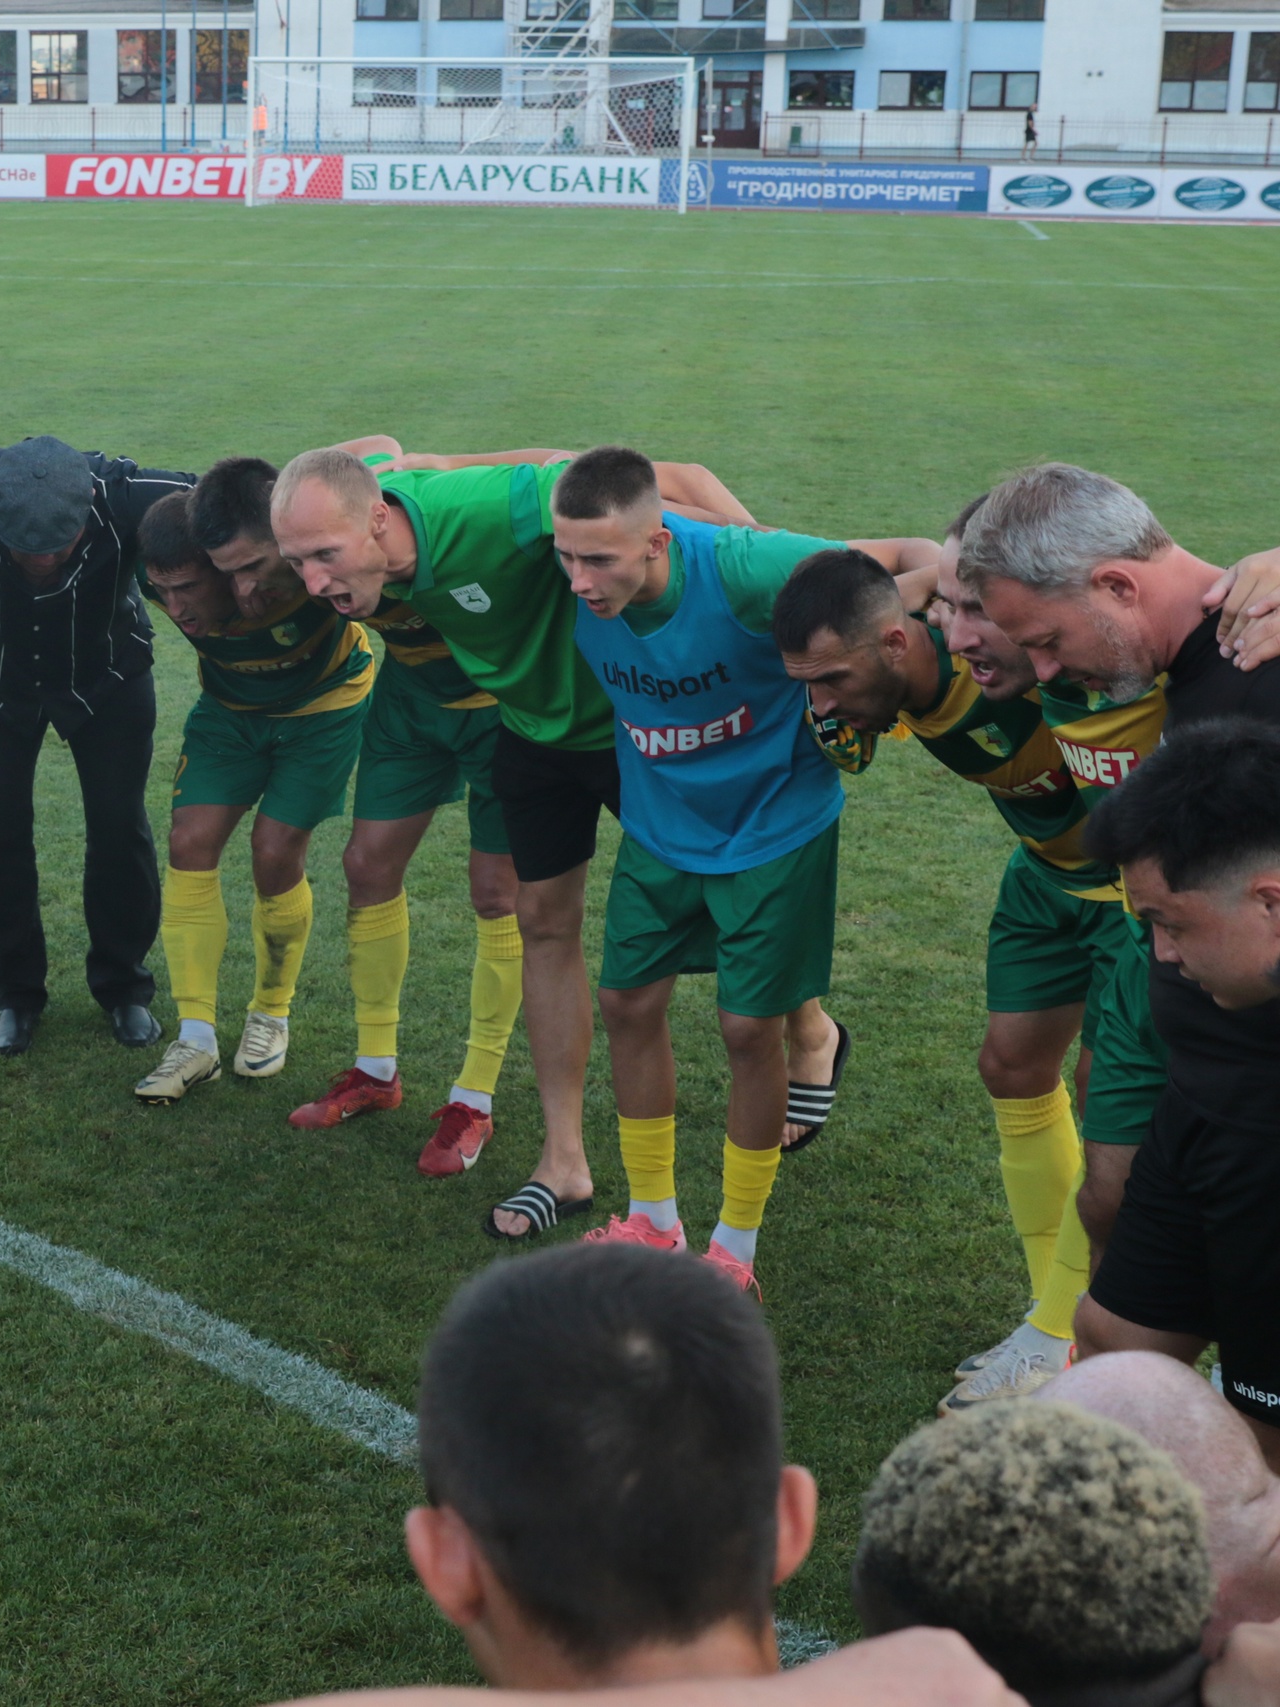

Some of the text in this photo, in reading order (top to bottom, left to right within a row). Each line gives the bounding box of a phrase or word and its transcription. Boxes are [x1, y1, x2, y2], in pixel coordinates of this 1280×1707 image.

[389, 163, 650, 194] БЕЛАРУСБАНК
[839, 168, 899, 179] УНИТАРНОЕ
[901, 170, 975, 181] ПРЕДПРИЯТИЕ
[602, 661, 731, 703] uhlsport
[620, 705, 747, 756] ONBET
[1055, 736, 1135, 784] NBET
[1233, 1380, 1280, 1408] uhlsp
